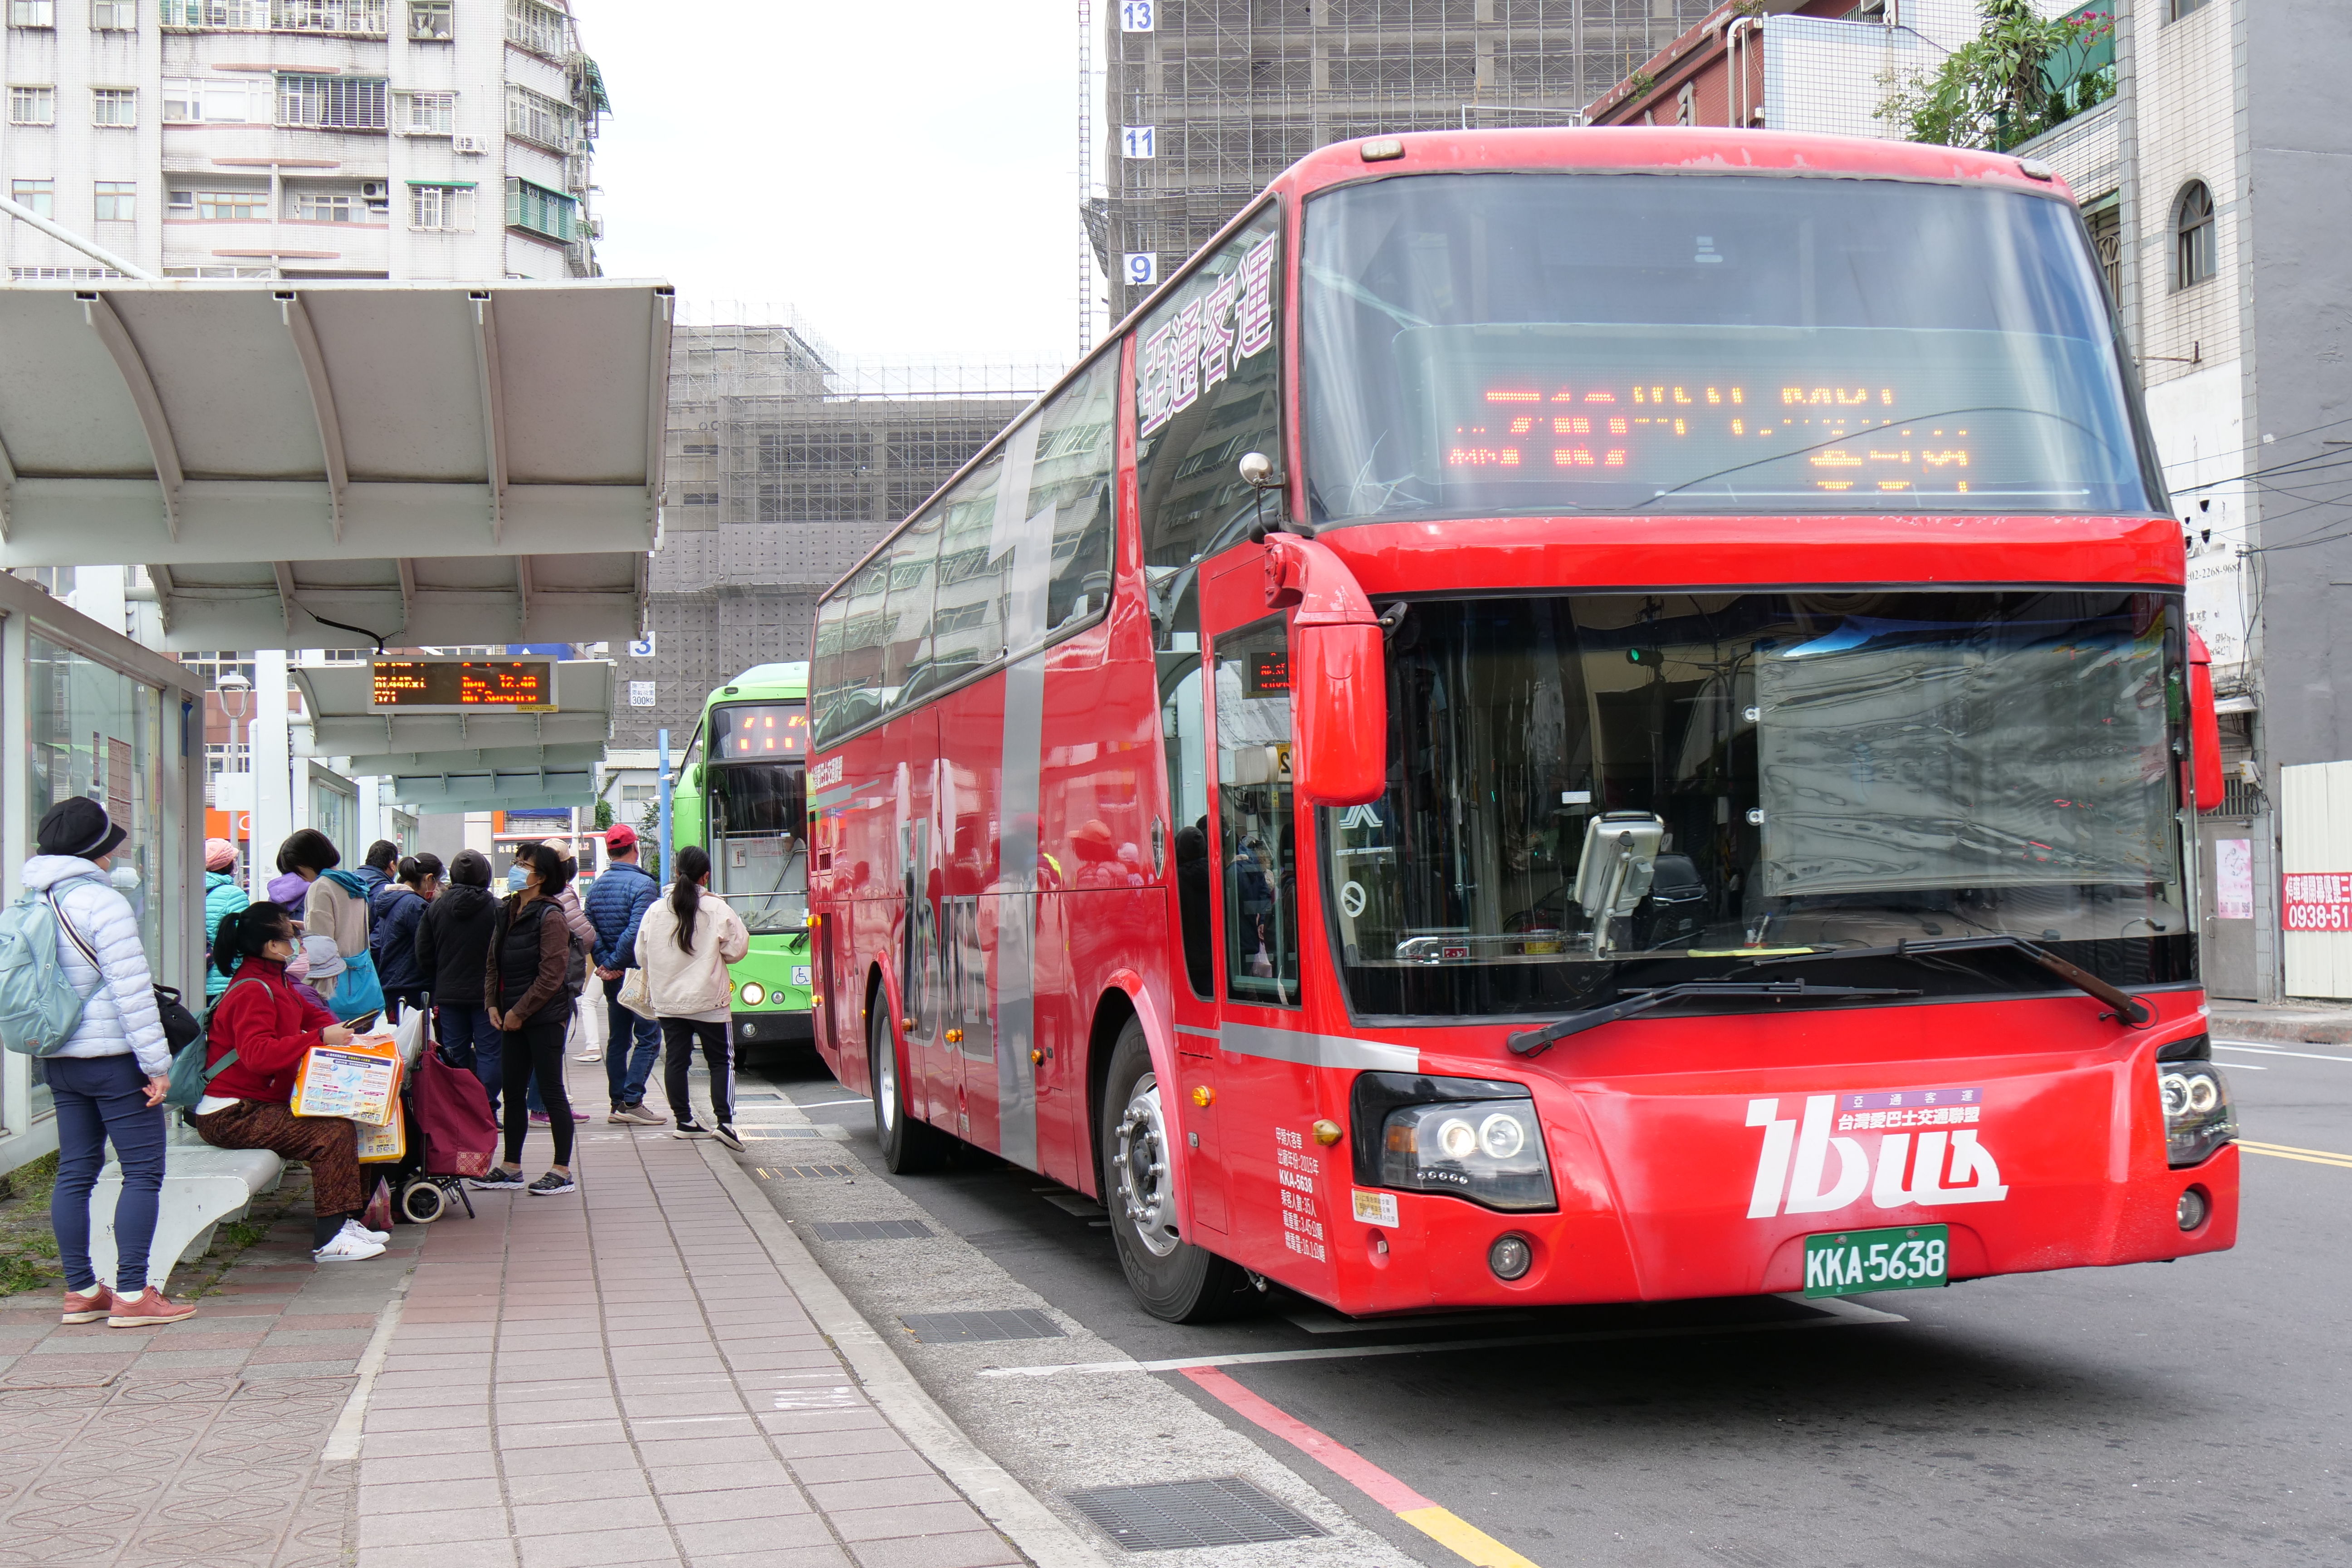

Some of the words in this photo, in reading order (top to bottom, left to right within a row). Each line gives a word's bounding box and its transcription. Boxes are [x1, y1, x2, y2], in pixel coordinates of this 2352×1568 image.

[1124, 2, 1151, 29] 13
[1126, 128, 1152, 157] 11
[1130, 256, 1152, 283] 9
[1141, 230, 1275, 438] 亞通客運
[634, 635, 651, 654] 3
[632, 696, 654, 705] 300kg
[2285, 875, 2352, 904] 停車場開幕優惠三
[2289, 904, 2352, 928] 0938-51
[1853, 1090, 1974, 1108] 亞通客運
[1838, 1106, 1980, 1131] 台灣愛巴士交通聯盟
[1276, 1127, 1303, 1150] 甲類大客車
[1279, 1169, 1313, 1194] KKA-5638
[1281, 1189, 1317, 1218] 乘客人數:35人
[1807, 1240, 1945, 1288] KKA-5638
